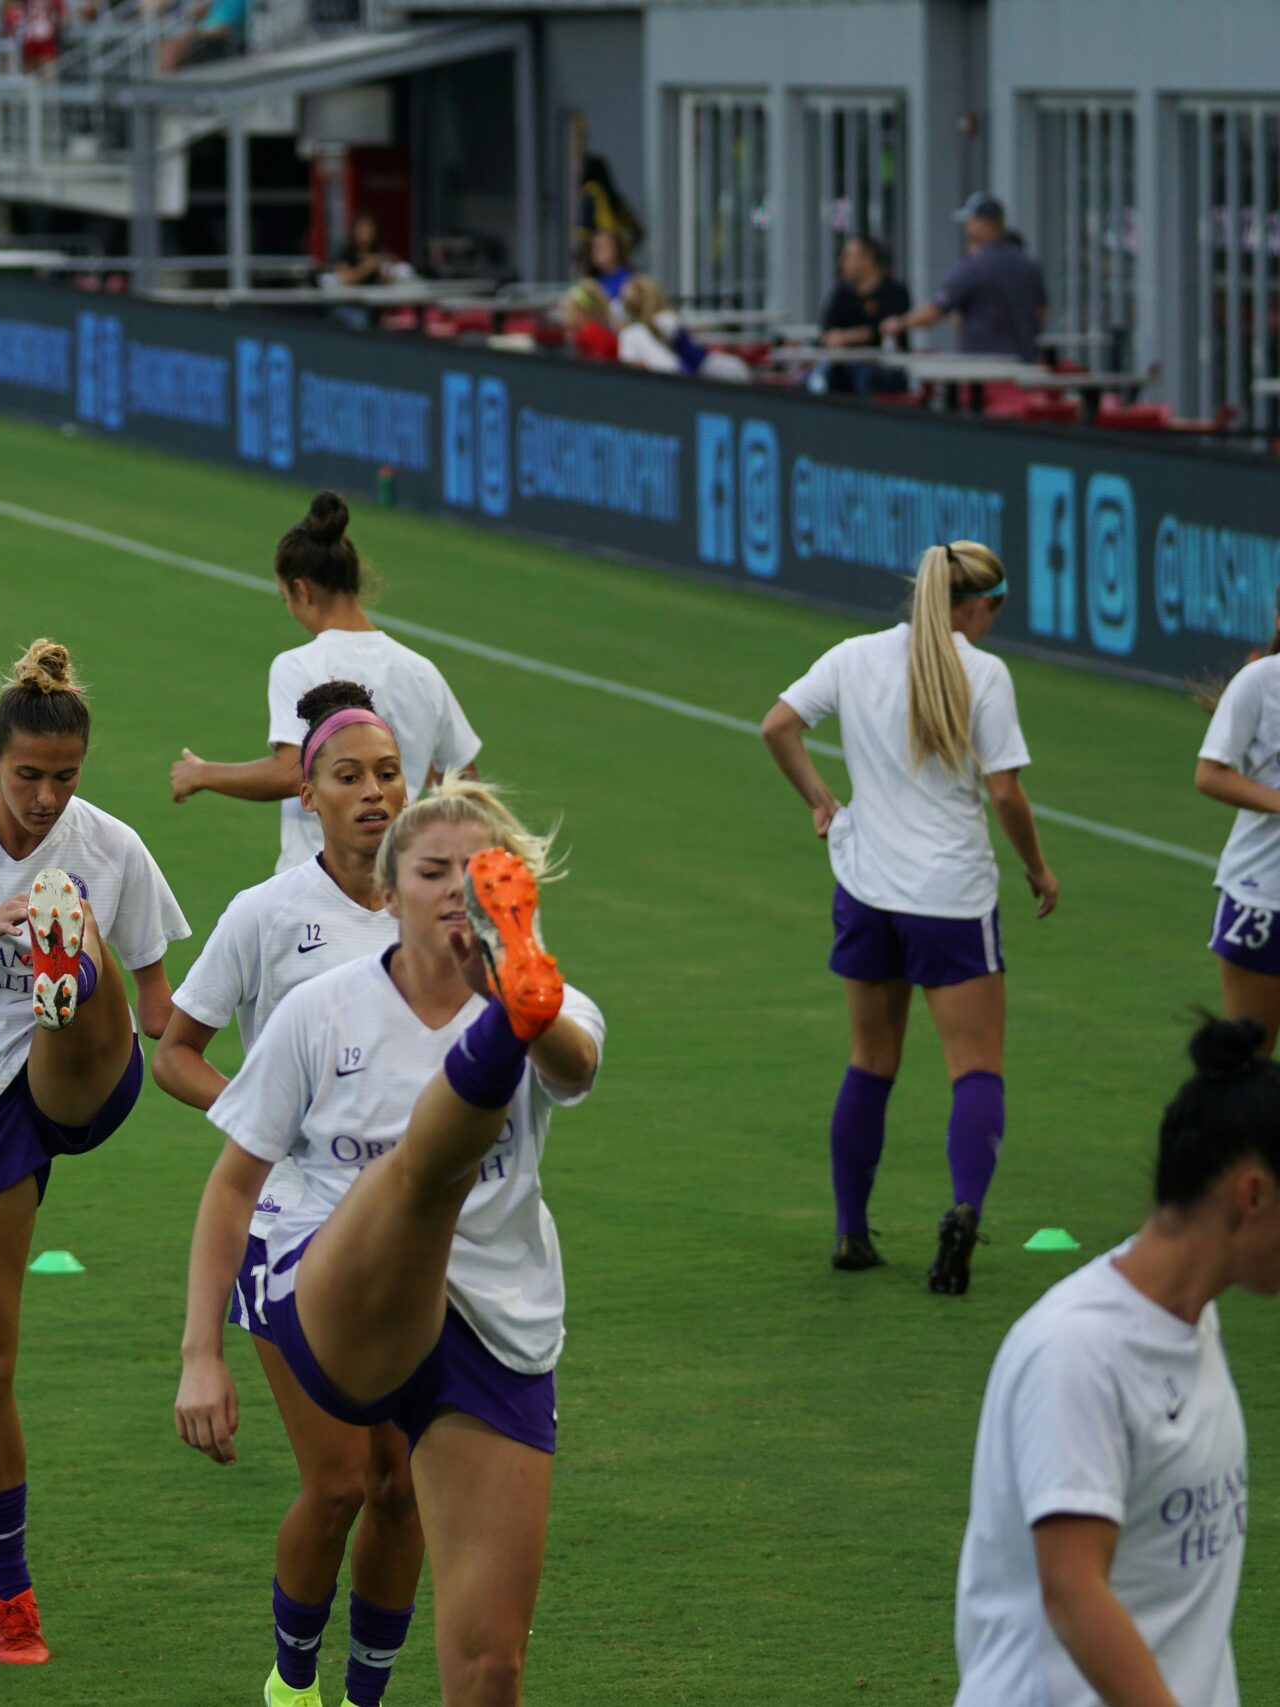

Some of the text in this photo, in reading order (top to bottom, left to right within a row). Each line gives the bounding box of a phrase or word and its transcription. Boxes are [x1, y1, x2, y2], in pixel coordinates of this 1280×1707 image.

[1154, 514, 1280, 644] @WASHIN
[306, 924, 321, 941] 12
[1223, 904, 1273, 949] 23
[343, 1047, 361, 1066] 19
